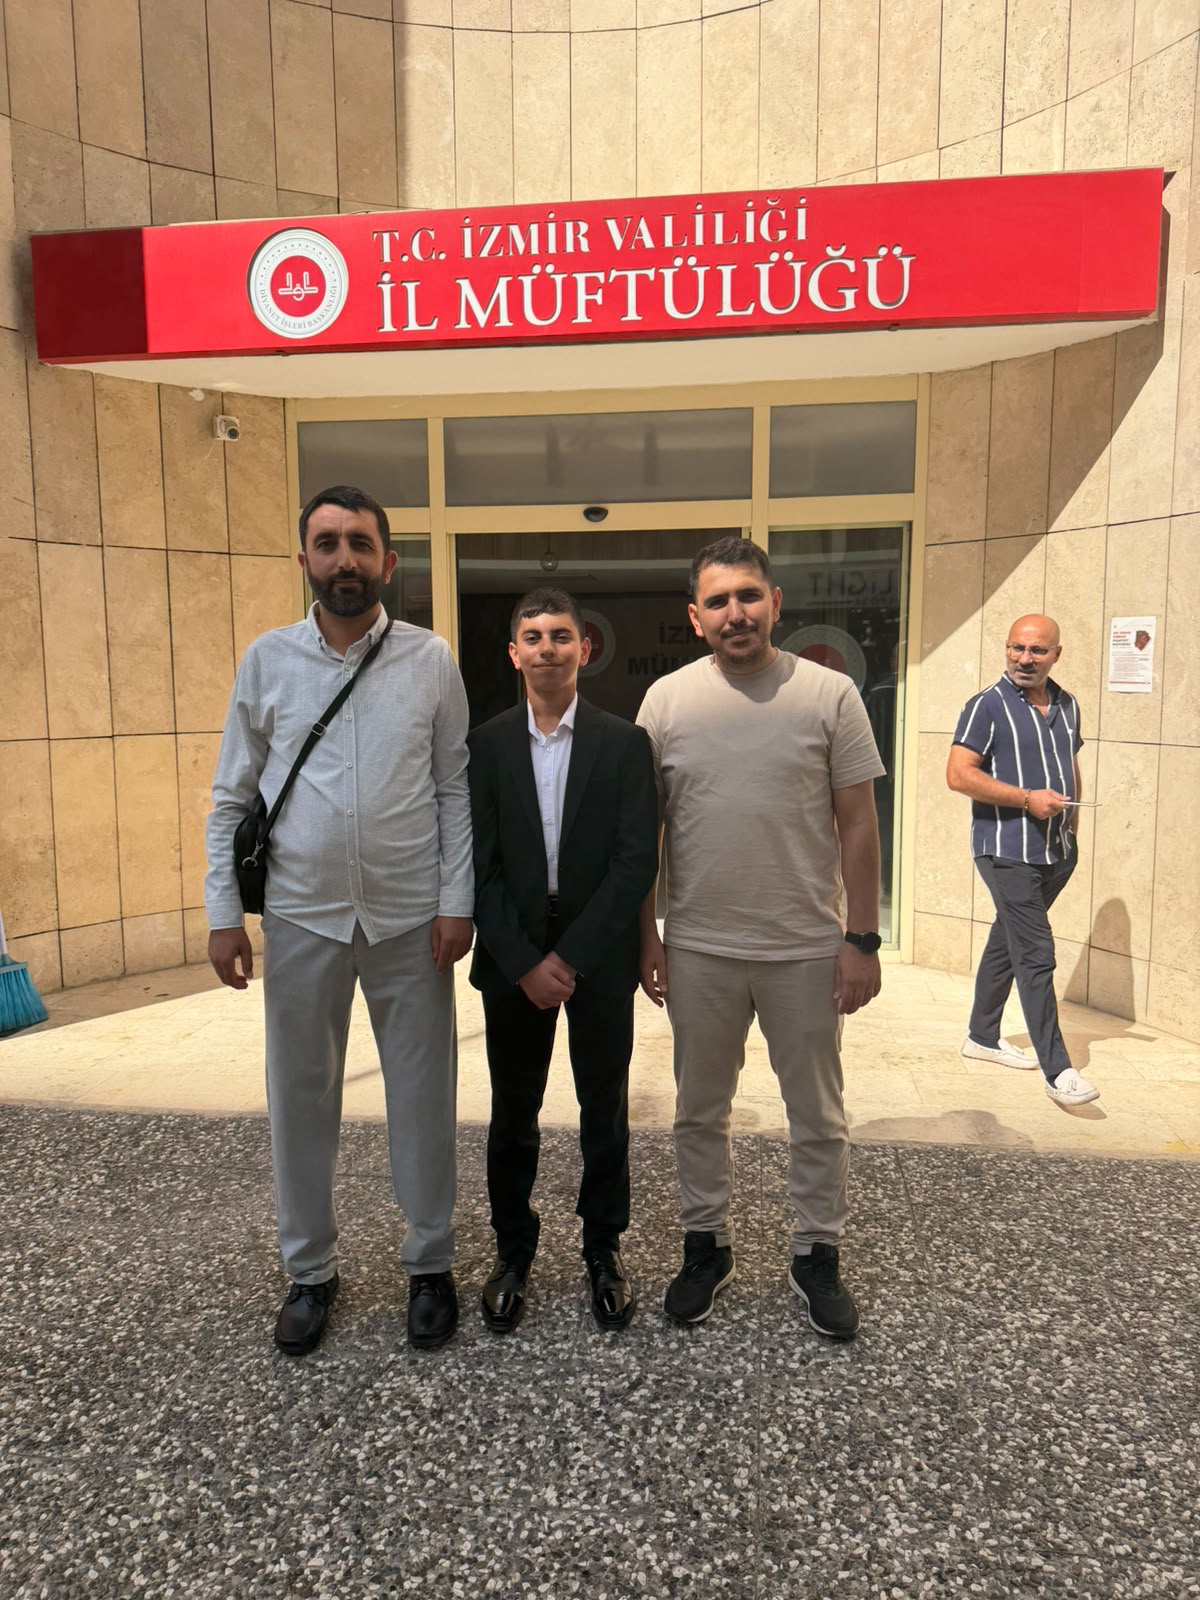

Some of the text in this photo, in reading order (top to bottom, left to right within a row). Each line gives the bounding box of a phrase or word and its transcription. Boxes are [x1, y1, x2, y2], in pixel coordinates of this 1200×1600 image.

[372, 196, 808, 263] T.C. İZMİR VALİLİĞİ
[260, 285, 337, 330] DİYANET İŞLERİ BAŞKANLIĞI
[376, 243, 916, 332] İL MÜFTÜLÜĞÜ
[659, 620, 705, 644] İZM
